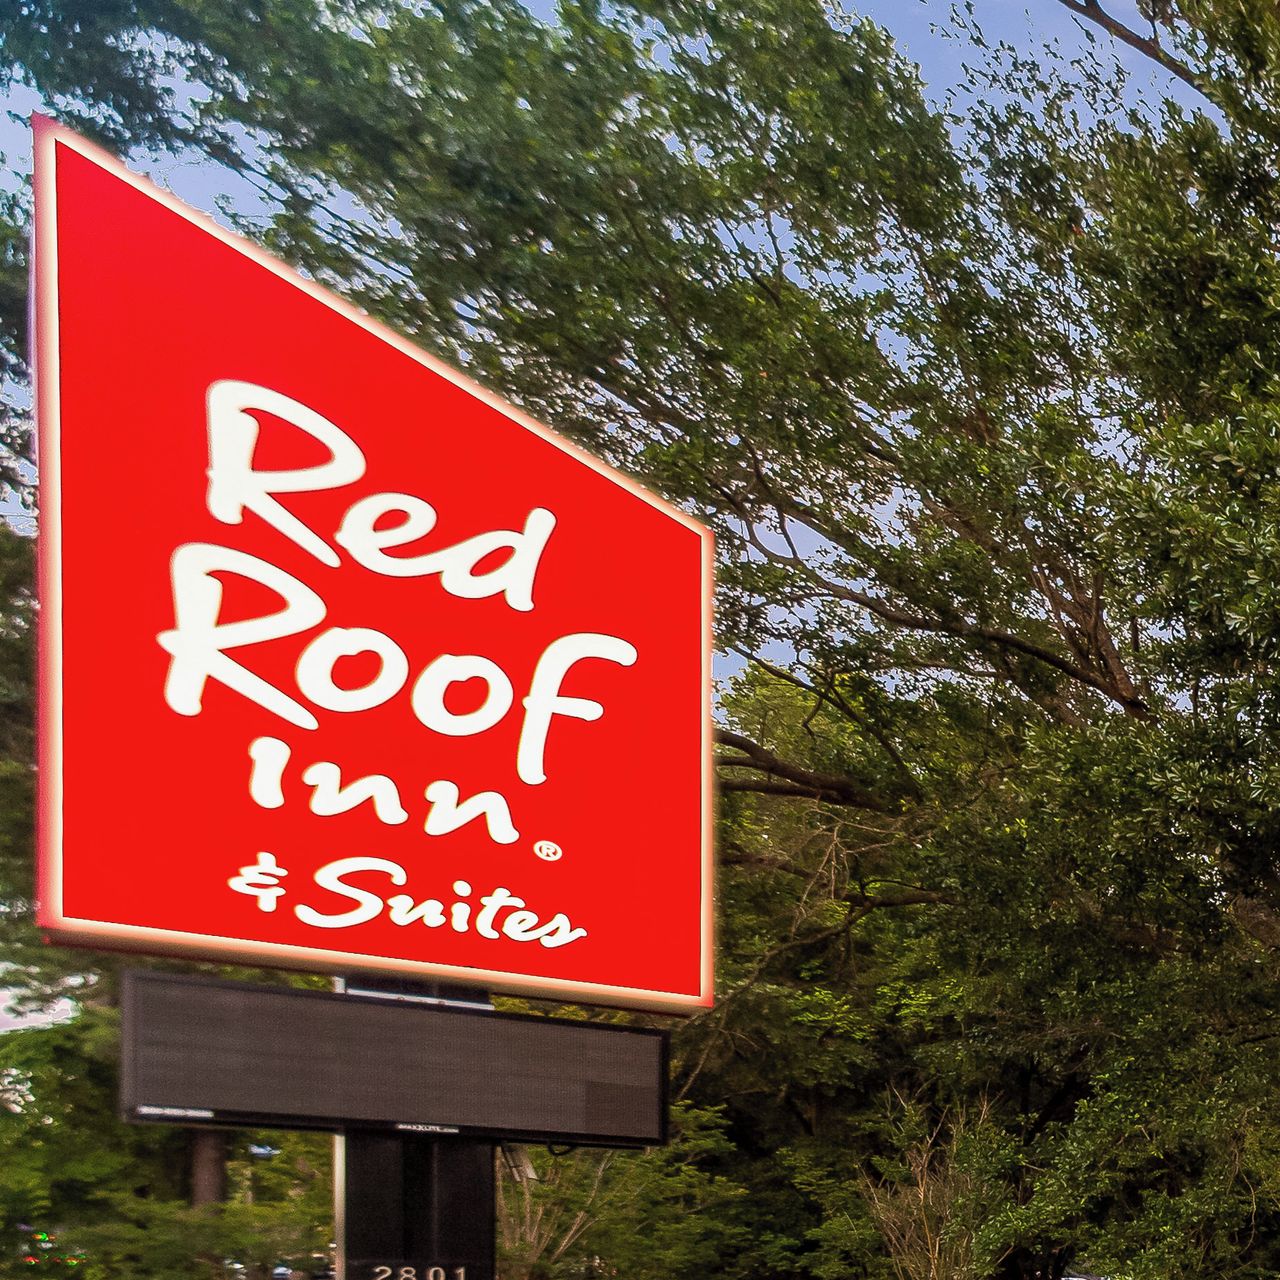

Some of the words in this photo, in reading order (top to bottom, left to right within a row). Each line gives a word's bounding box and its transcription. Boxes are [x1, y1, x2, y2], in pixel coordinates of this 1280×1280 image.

[205, 379, 557, 613] Red
[156, 541, 638, 785] Roof
[228, 852, 289, 913] &
[294, 856, 587, 949] Suites
